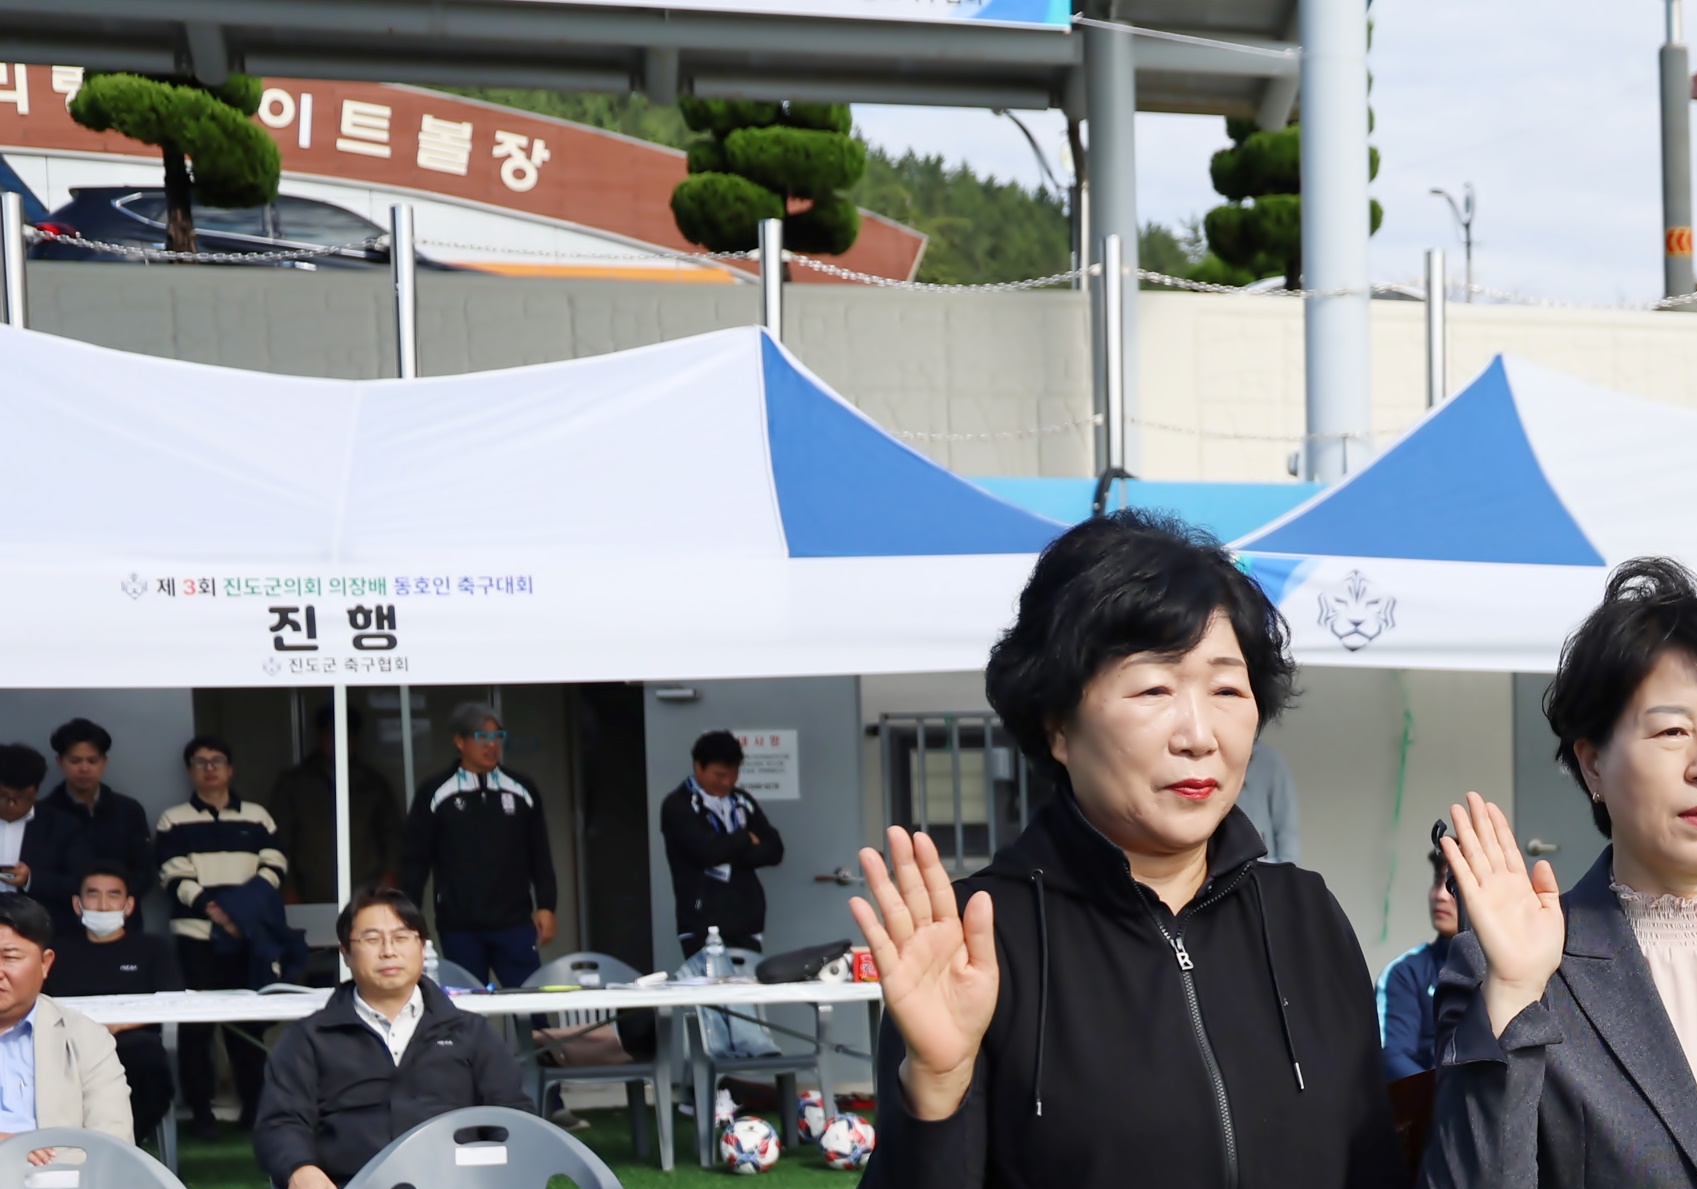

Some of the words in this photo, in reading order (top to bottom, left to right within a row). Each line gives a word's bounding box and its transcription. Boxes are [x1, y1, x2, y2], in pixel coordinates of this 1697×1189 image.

[257, 87, 551, 192] 이트볼장
[157, 576, 176, 597] 제
[183, 577, 216, 597] 3회
[223, 576, 321, 597] 진도군의회
[329, 576, 387, 597] 의장배
[394, 575, 450, 596] 동호인
[458, 575, 533, 595] 축구대회
[288, 657, 337, 673] 진도군
[344, 656, 409, 673] 축구협회
